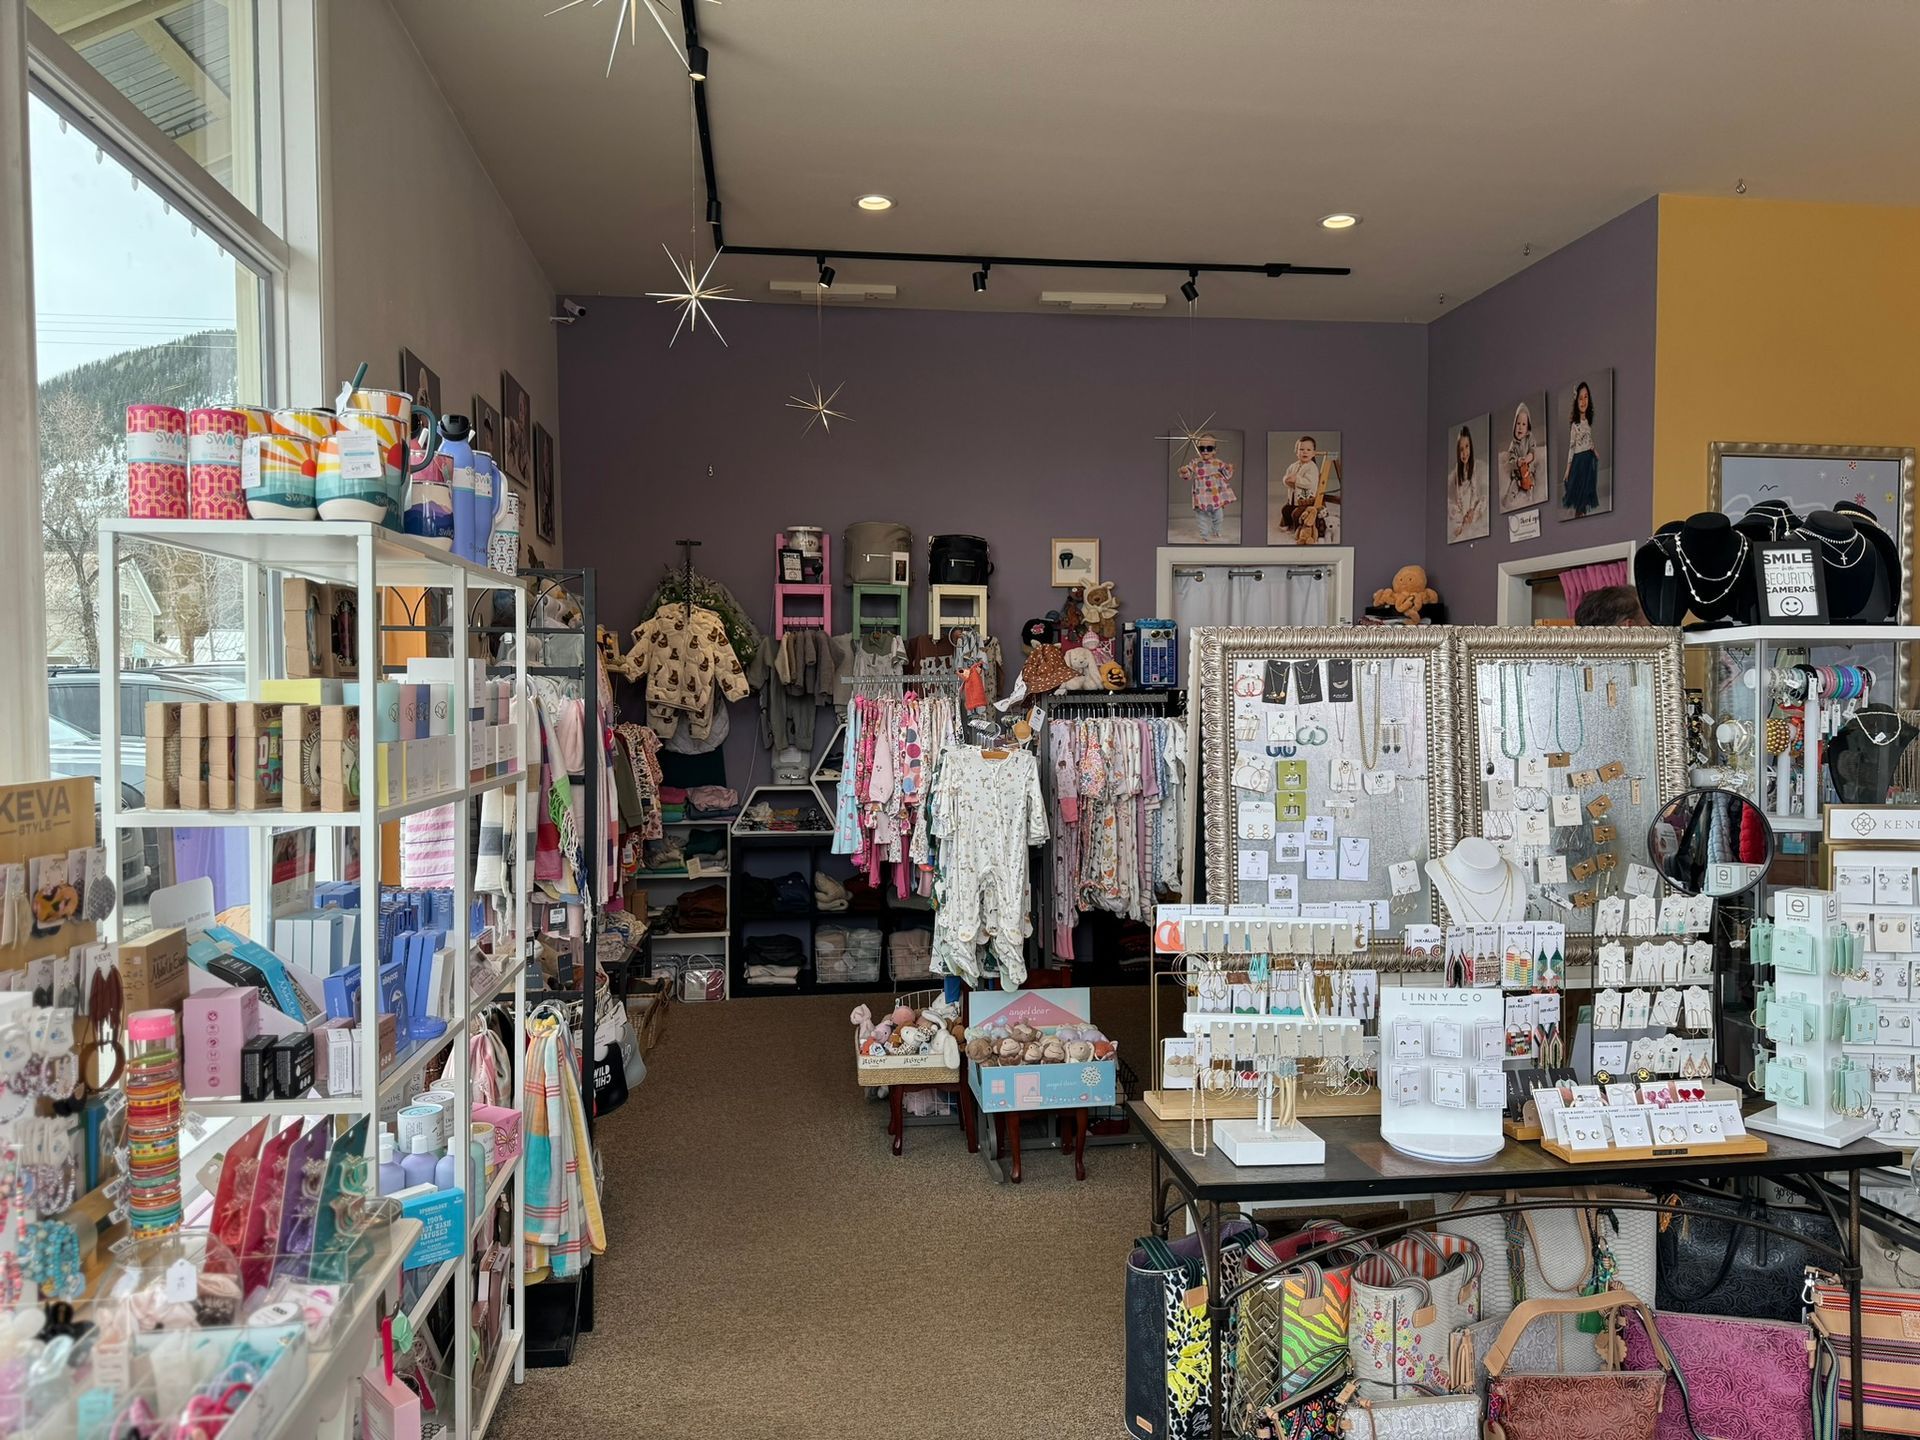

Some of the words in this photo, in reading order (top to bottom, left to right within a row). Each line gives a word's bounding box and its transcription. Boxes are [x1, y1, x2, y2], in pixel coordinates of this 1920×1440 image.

[1763, 553, 1813, 564] SMILE
[1765, 572, 1814, 586] SECURITY
[18, 822, 52, 836] STYLE
[1401, 992, 1448, 1001] LINNY
[1460, 993, 1482, 1002] CO
[1009, 1007, 1030, 1019] angel
[1031, 1005, 1050, 1015] dear
